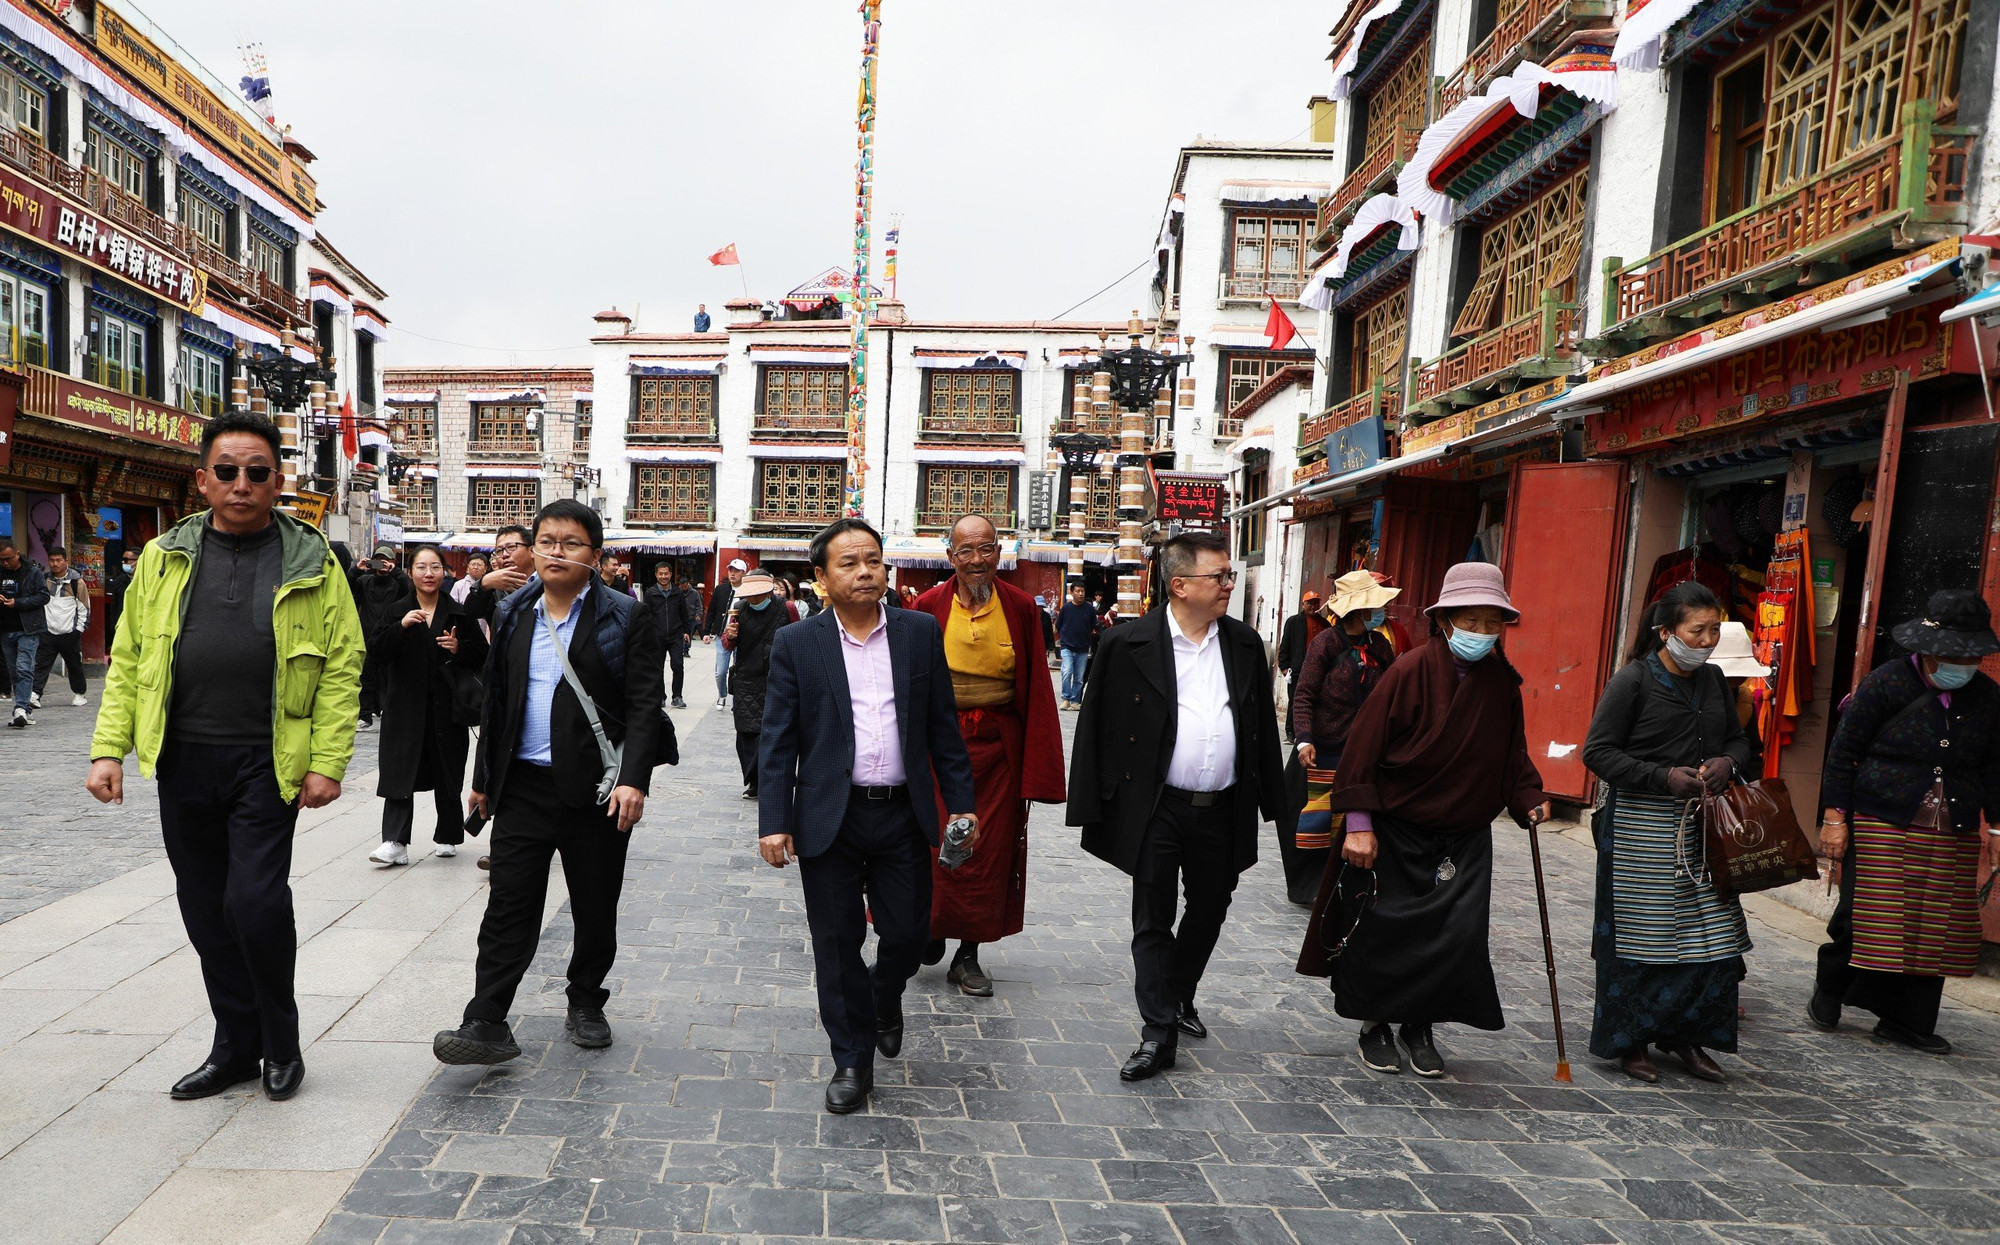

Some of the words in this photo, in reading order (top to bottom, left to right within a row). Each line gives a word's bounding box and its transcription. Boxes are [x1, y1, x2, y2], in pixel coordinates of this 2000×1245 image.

[1164, 485, 1217, 498] 安全出口
[1163, 507, 1179, 517] Exit
